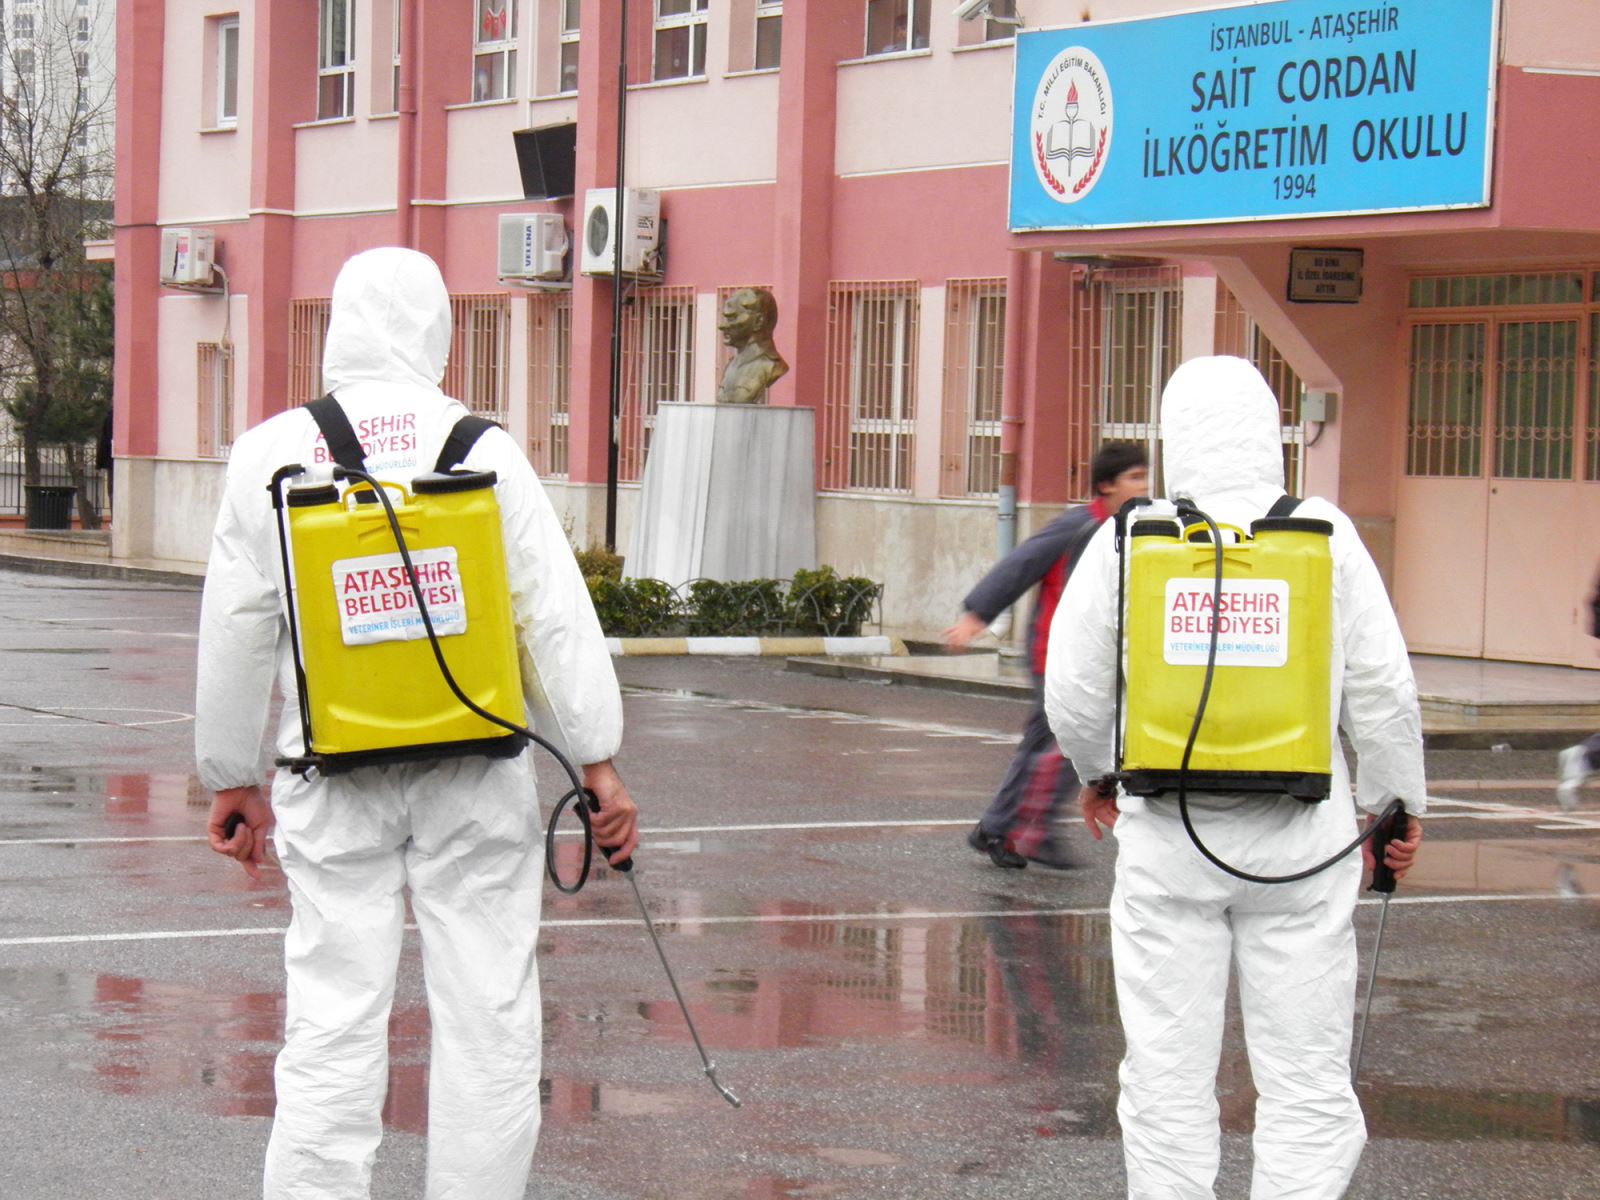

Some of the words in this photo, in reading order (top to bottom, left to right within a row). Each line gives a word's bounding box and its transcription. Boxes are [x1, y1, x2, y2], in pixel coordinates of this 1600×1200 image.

[1210, 20, 1292, 52] İSTANBUL
[1310, 1, 1399, 44] ATAŞEHİR
[1060, 57, 1083, 72] EĞİTİM
[1083, 62, 1107, 115] BAKANLIĞI
[1191, 56, 1256, 113] SAİT
[1277, 49, 1417, 104] CORDAN
[1143, 114, 1328, 178] İLKÖĞRETİM
[1352, 111, 1467, 163] OKULU
[1273, 174, 1317, 200] 1994
[1172, 592, 1280, 614] ATAŞEHİR
